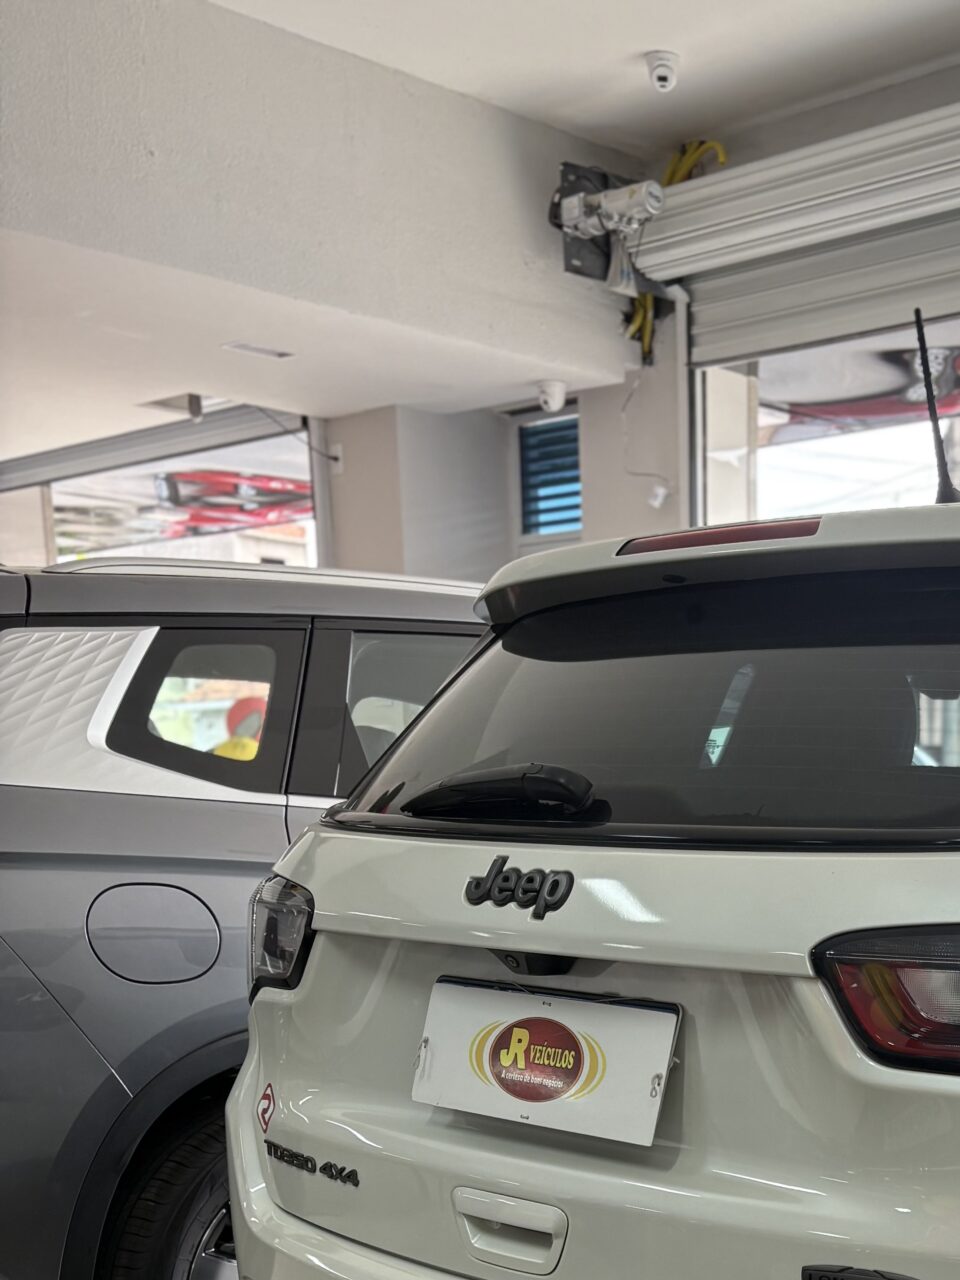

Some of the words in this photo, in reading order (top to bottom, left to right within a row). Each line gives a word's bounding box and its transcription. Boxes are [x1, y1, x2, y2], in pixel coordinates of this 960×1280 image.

[465, 854, 575, 921] Jeep
[500, 1027, 530, 1069] JR
[530, 1041, 576, 1069] VEÍCULOS
